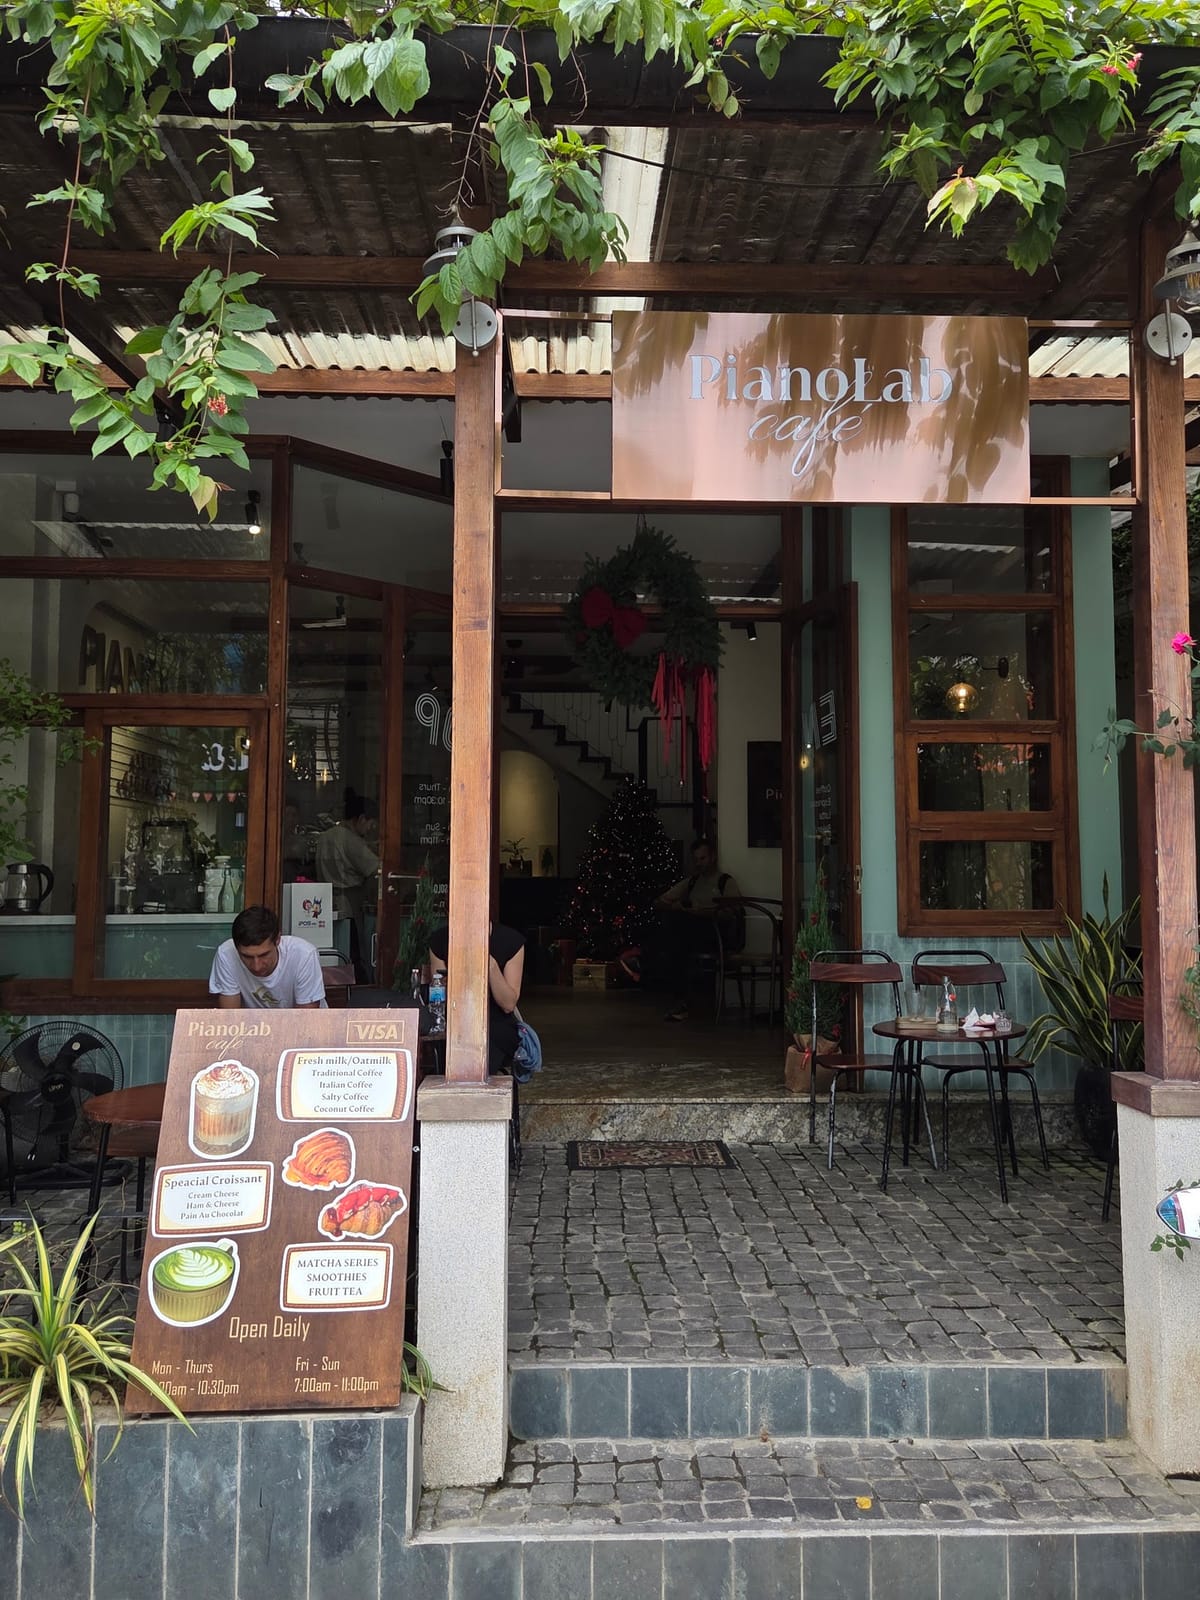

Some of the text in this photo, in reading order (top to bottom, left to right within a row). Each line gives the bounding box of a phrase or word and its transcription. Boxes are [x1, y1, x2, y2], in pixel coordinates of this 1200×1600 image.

[689, 354, 953, 403] PianoLab
[747, 374, 872, 478] café
[188, 1022, 271, 1036] PianoLab
[354, 1025, 397, 1039] VISA
[297, 1056, 391, 1065] Fresh milk/Oatmilk
[322, 1093, 342, 1102] Salty
[165, 1175, 262, 1189] Speacial Croissant
[298, 1258, 378, 1268] MATCHA SERIES
[307, 1273, 367, 1282] SMOOTHIES
[309, 1287, 362, 1296] FRUIT TEA
[230, 1316, 310, 1342] Open Daily
[152, 1360, 172, 1374] Mon
[185, 1360, 213, 1373] Thurs
[296, 1358, 309, 1371] Fri
[322, 1358, 340, 1371] Sun
[198, 1380, 239, 1396] 10:30pm
[294, 1379, 331, 1393] 7:00am
[342, 1378, 379, 1392] 11:00pm
